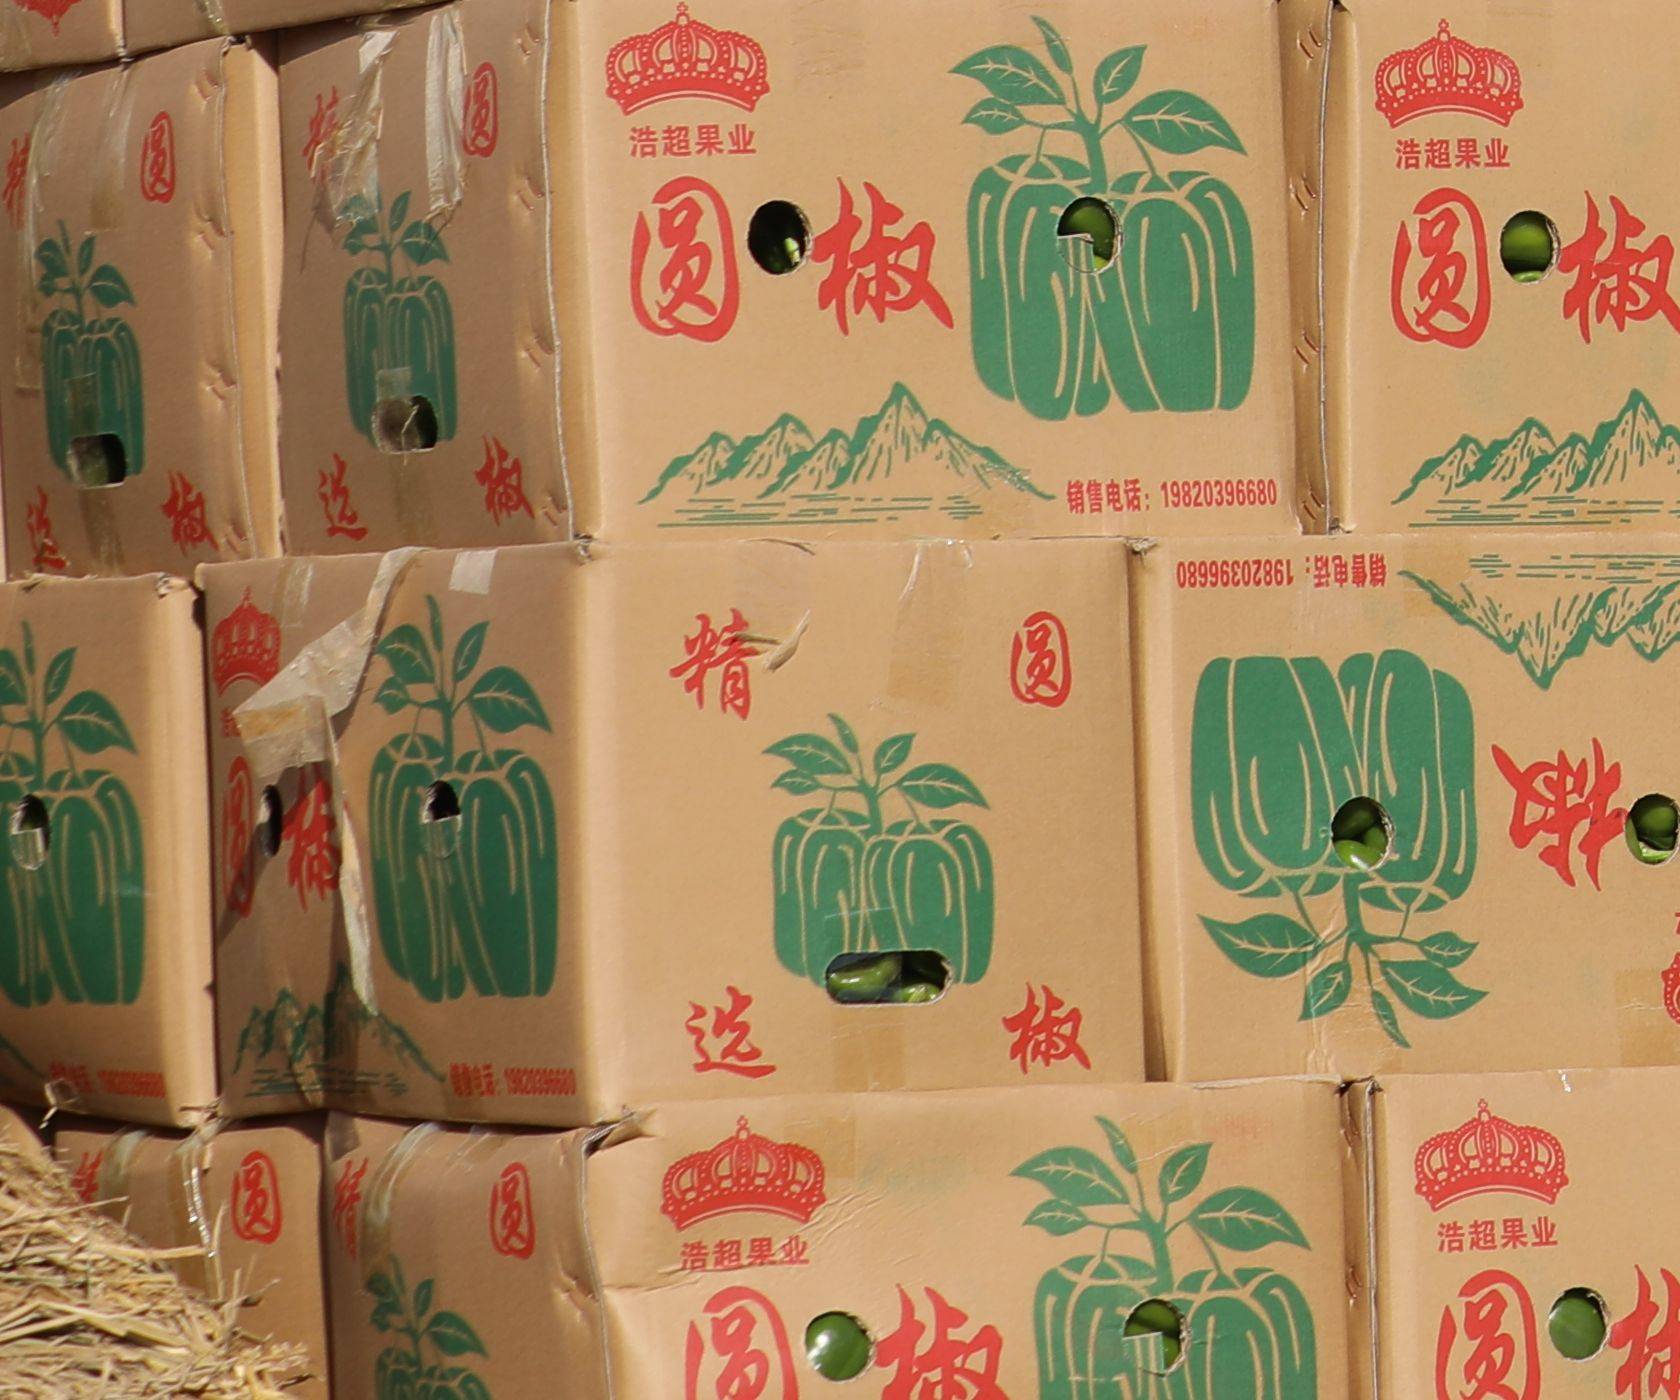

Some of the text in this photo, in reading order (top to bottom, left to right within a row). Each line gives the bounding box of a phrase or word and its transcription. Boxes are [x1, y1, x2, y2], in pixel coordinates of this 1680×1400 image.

[462, 63, 499, 158] 圆
[632, 124, 754, 157] 浩超果业
[1396, 139, 1510, 169] 浩超果业
[140, 112, 176, 204] 圆
[631, 176, 954, 342] 圆椒
[318, 453, 368, 541] 选
[474, 437, 534, 525] 椒
[25, 486, 67, 575] 选
[670, 609, 759, 719] 精
[1010, 611, 1072, 708] 圆
[686, 986, 776, 1079] 选
[1002, 985, 1091, 1074] 椒
[230, 1150, 283, 1245] 圆
[488, 1162, 536, 1260] 圆
[1438, 1217, 1557, 1252] 浩超果业
[681, 1236, 808, 1271] 浩超果业
[686, 1287, 1009, 1400] 圆椒
